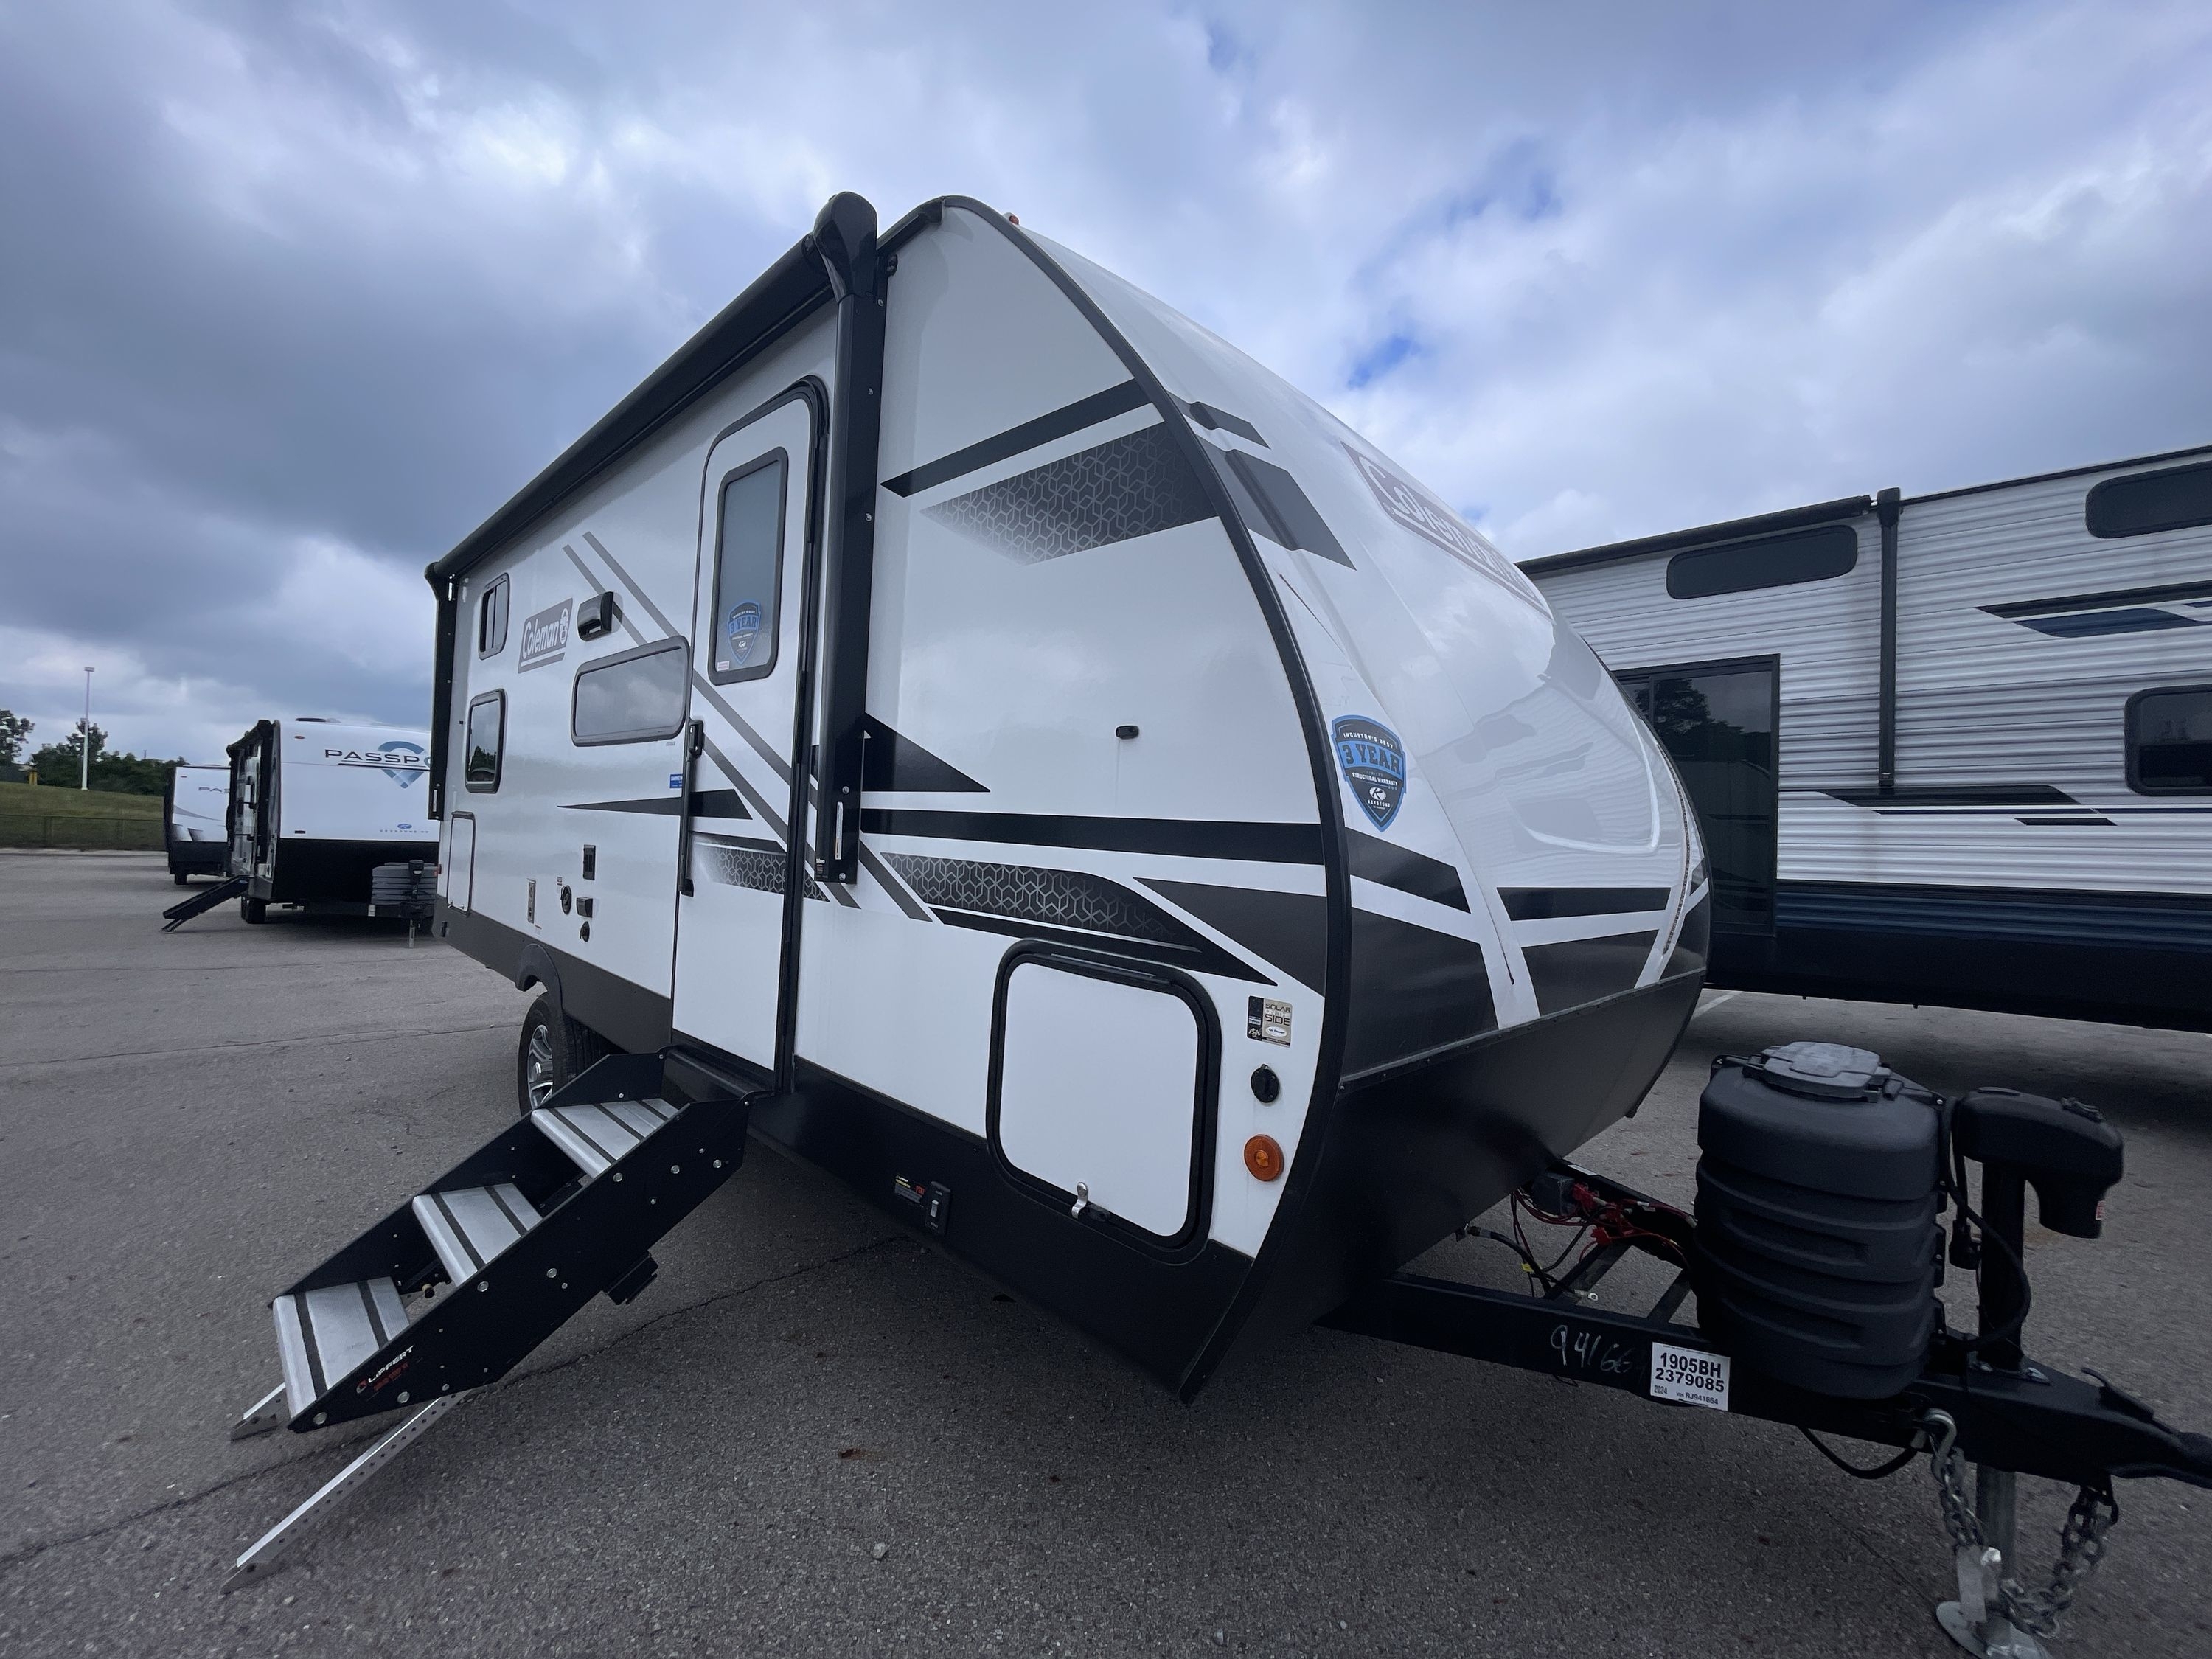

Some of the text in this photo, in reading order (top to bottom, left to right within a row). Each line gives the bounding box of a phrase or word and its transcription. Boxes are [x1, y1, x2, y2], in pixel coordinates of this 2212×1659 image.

[737, 615, 757, 630] YEAR
[523, 618, 560, 659] Coleman
[1343, 732, 1393, 749] INDUSTRY'S BEST
[1342, 743, 1401, 776] 3 YEAR
[1352, 772, 1398, 786] STRUCTURAL WARRANTY
[1367, 799, 1391, 807] KEYSTONE
[1265, 1003, 1291, 1012] SOLAR
[1265, 1014, 1290, 1026] SIDE
[368, 1345, 414, 1383] LIPPERT
[1660, 1352, 1721, 1378] 1905BH
[1655, 1368, 1724, 1393] 2379085
[1654, 1385, 1667, 1395] 2024
